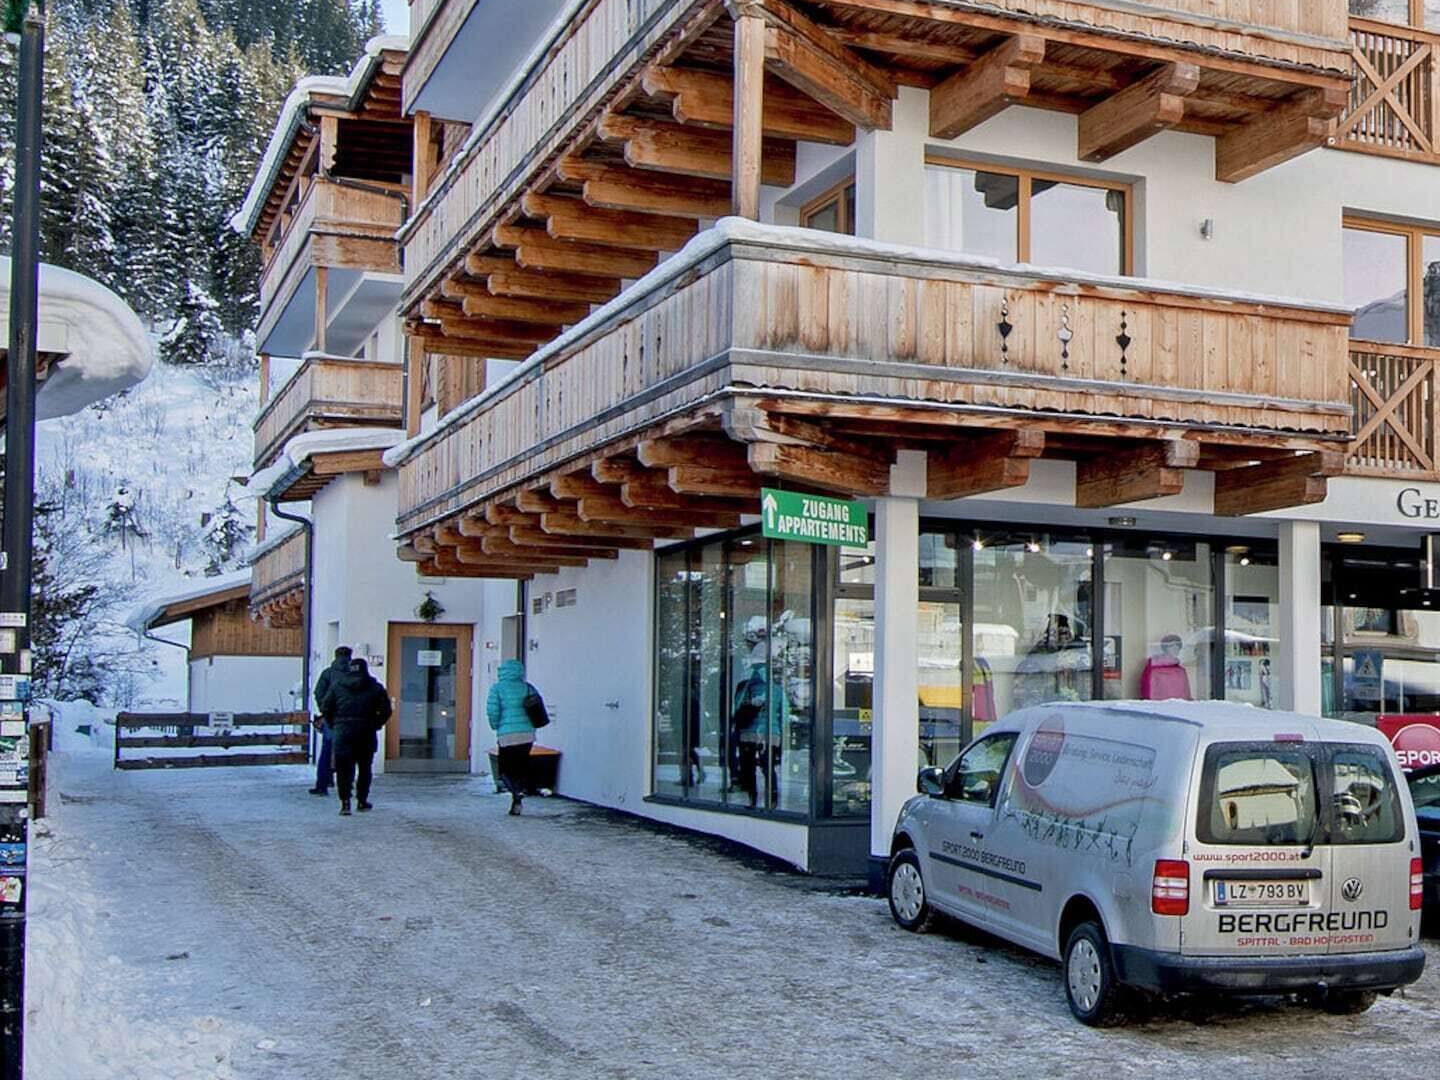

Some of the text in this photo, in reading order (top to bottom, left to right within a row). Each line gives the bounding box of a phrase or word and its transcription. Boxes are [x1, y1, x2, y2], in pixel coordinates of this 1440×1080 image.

[802, 499, 850, 522] ZUGANG
[778, 515, 866, 544] APPARTEMENTS
[1193, 851, 1300, 864] www.sport2000.at
[1218, 910, 1388, 933] BERGFREUND
[1237, 937, 1281, 946] SPITTAL
[1289, 936, 1311, 946] BAD
[1314, 933, 1374, 945] HOFGASTEIN
